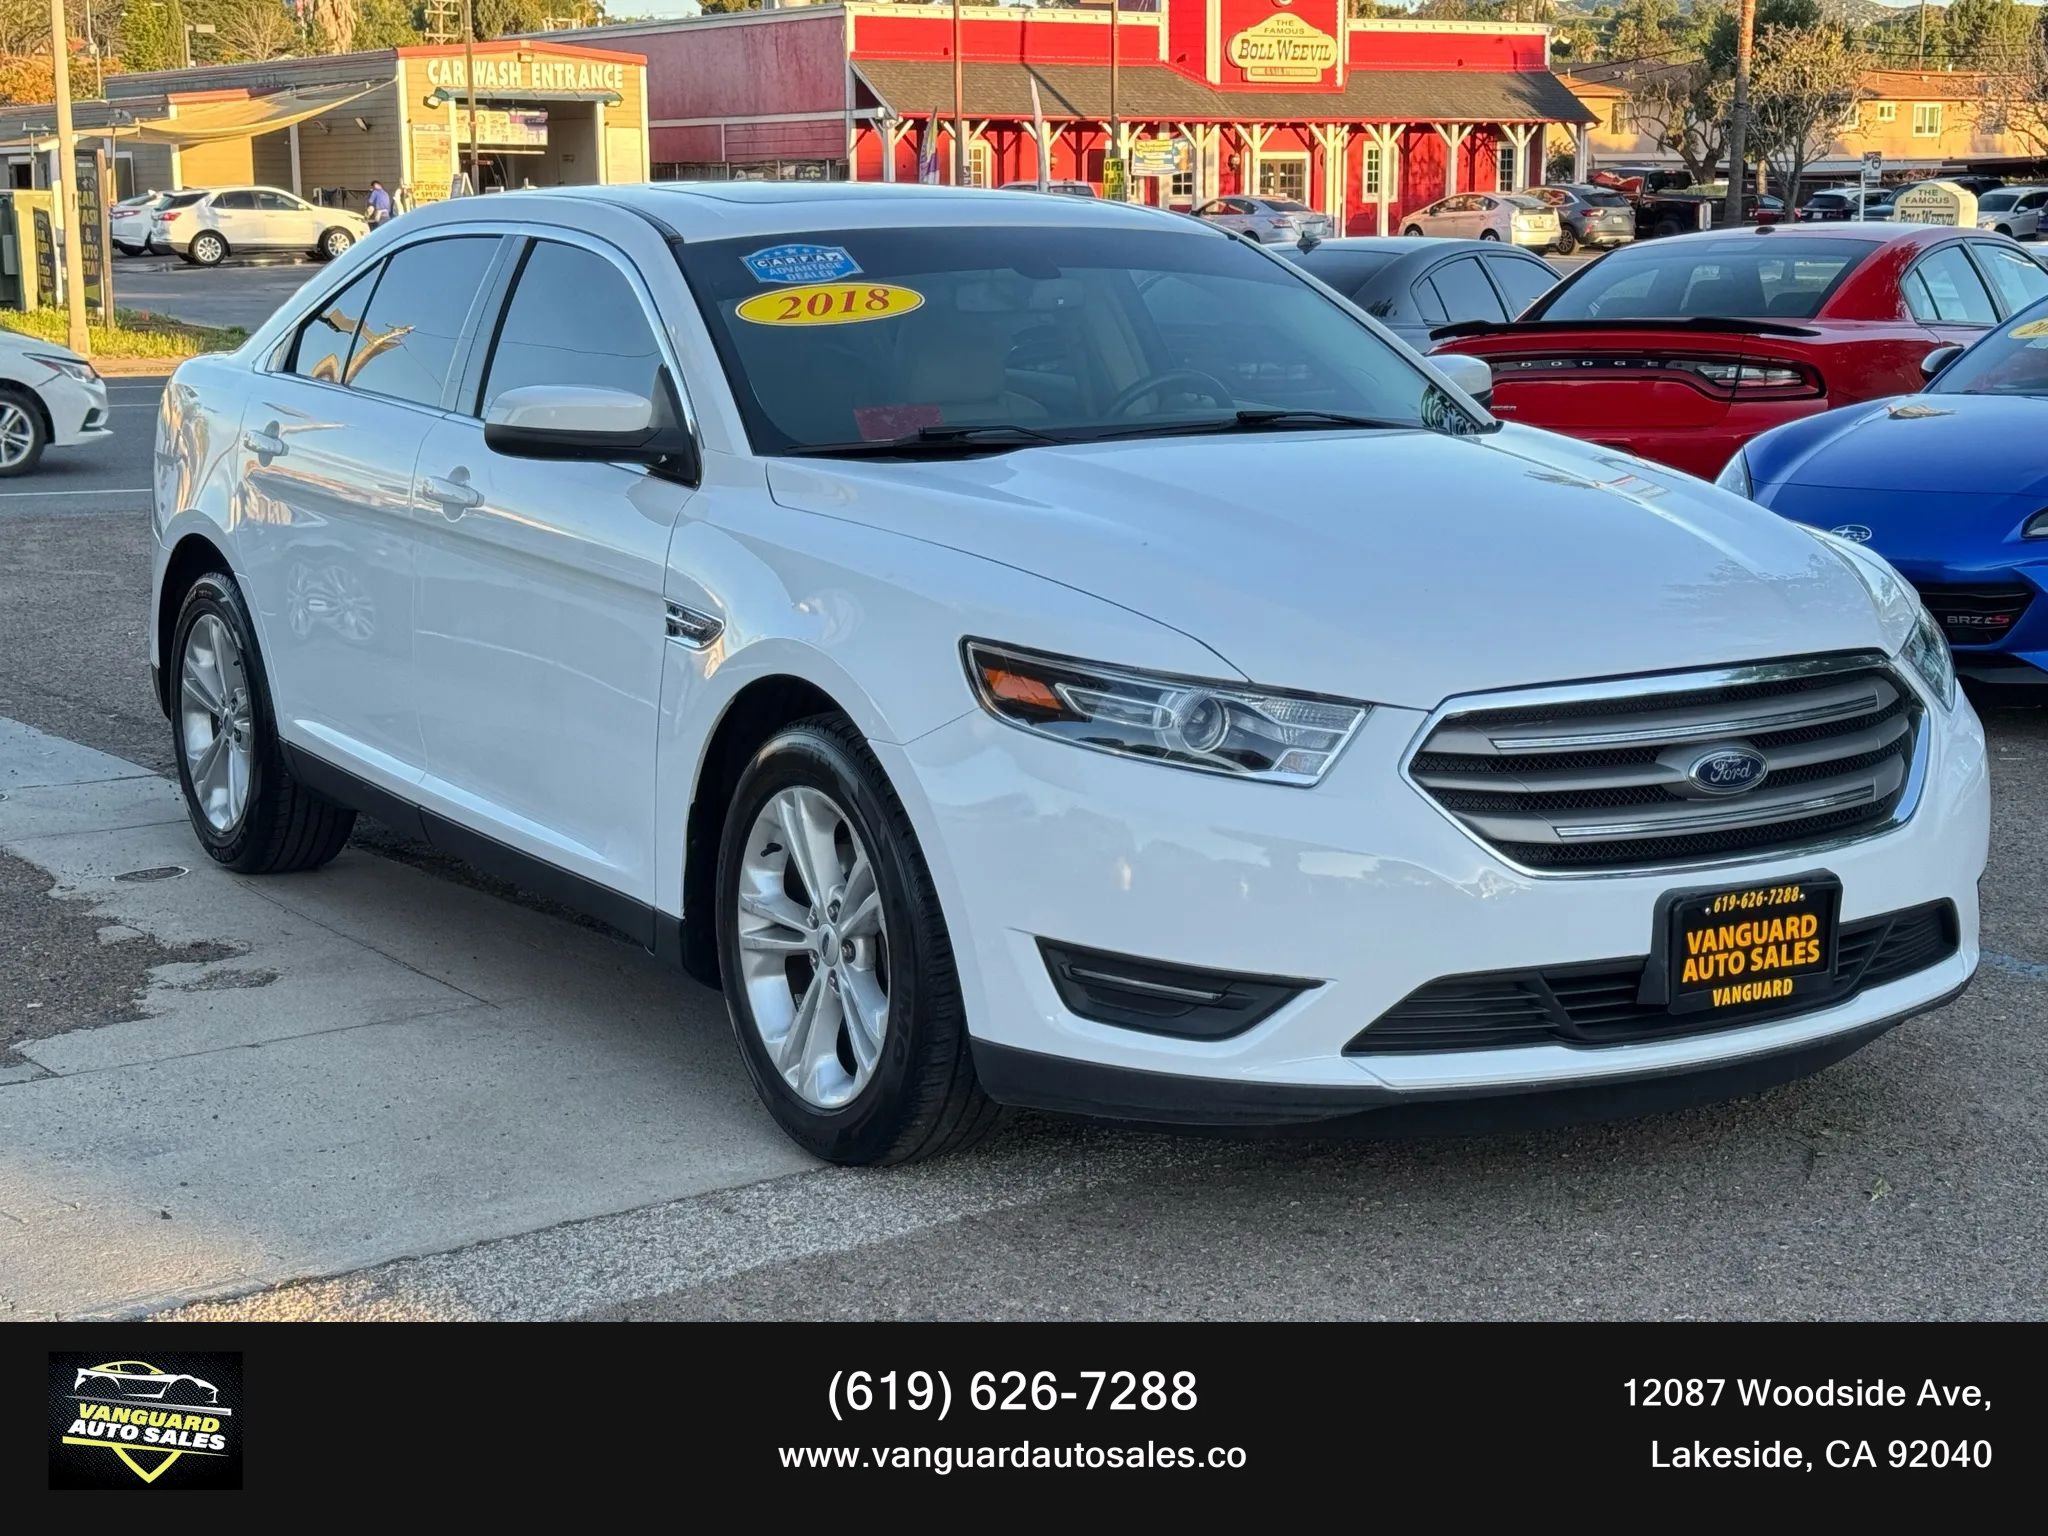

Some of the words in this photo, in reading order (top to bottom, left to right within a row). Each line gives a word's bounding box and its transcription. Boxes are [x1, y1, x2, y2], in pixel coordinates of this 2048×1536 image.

[1264, 27, 1305, 35] FAMOUS
[1276, 19, 1294, 27] THE
[1238, 38, 1276, 60] BOLL
[1276, 39, 1332, 61] WEEVIL
[427, 59, 465, 86] CAR
[472, 60, 522, 88] WASH
[532, 63, 624, 89] ENTRANCE
[1918, 188, 1939, 196] THE
[756, 251, 845, 269] CARFAX
[769, 261, 844, 276] ADVANTAGE
[786, 270, 835, 282] DEALER
[777, 288, 890, 321] 2018
[1520, 359, 1659, 368] DODGE
[1947, 615, 1984, 624] BRZ
[1710, 758, 1752, 782] Ford
[1713, 886, 1800, 914] 619-626-7288
[1687, 914, 1818, 955] VANGUARD
[1682, 950, 1745, 983] AUTO
[1750, 939, 1820, 972] SALES
[1713, 978, 1793, 1007] VANGUARD
